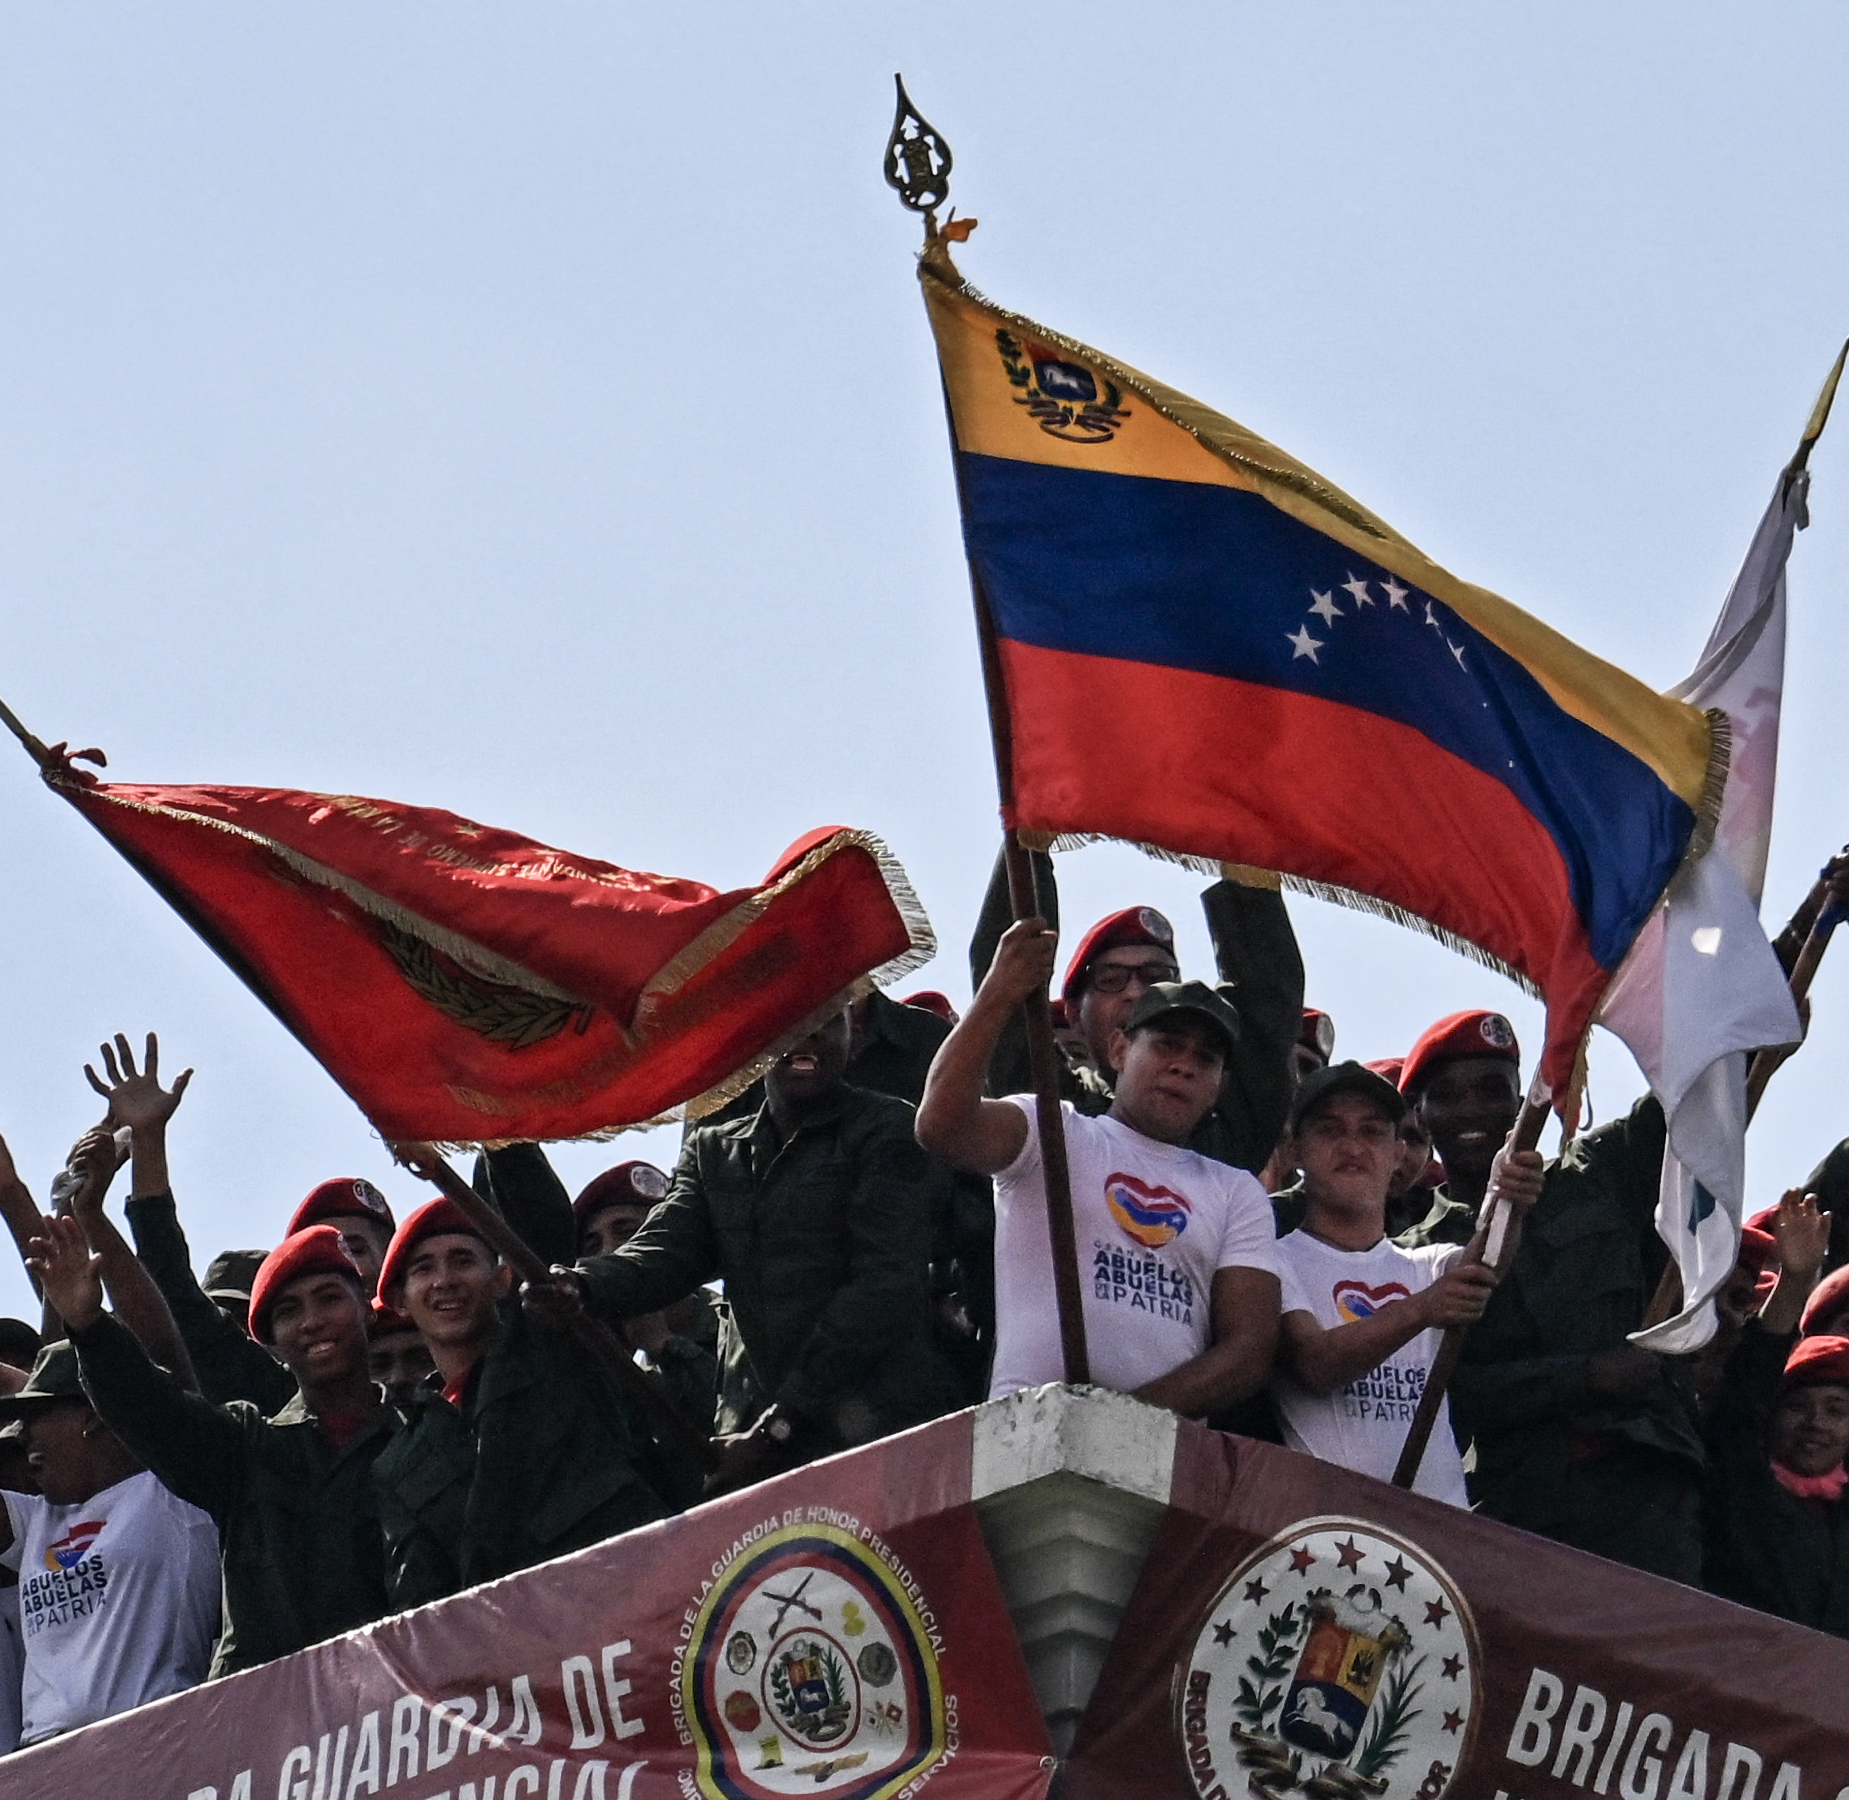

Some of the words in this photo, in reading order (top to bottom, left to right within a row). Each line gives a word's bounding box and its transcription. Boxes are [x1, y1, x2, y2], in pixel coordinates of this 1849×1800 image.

[1094, 1265, 1193, 1307] ABUELAS
[1113, 1285, 1193, 1328] PATRIA
[1363, 1367, 1426, 1386] UELOS
[1360, 1400, 1416, 1422] PATR
[782, 1507, 803, 1526] DE
[808, 1506, 860, 1536] HONOR
[711, 1516, 780, 1578] GUARDIA
[22, 1555, 104, 1601] ABUELOS
[24, 1571, 108, 1617] ABUELAS
[692, 1579, 714, 1605] LA
[860, 1526, 947, 1662] PRESIDENCIAL
[35, 1590, 106, 1634] PATRIA
[680, 1610, 698, 1640] DE
[561, 1639, 645, 1750] DE
[669, 1643, 693, 1746] BRIGADA
[1184, 1670, 1216, 1791] BRIGADA
